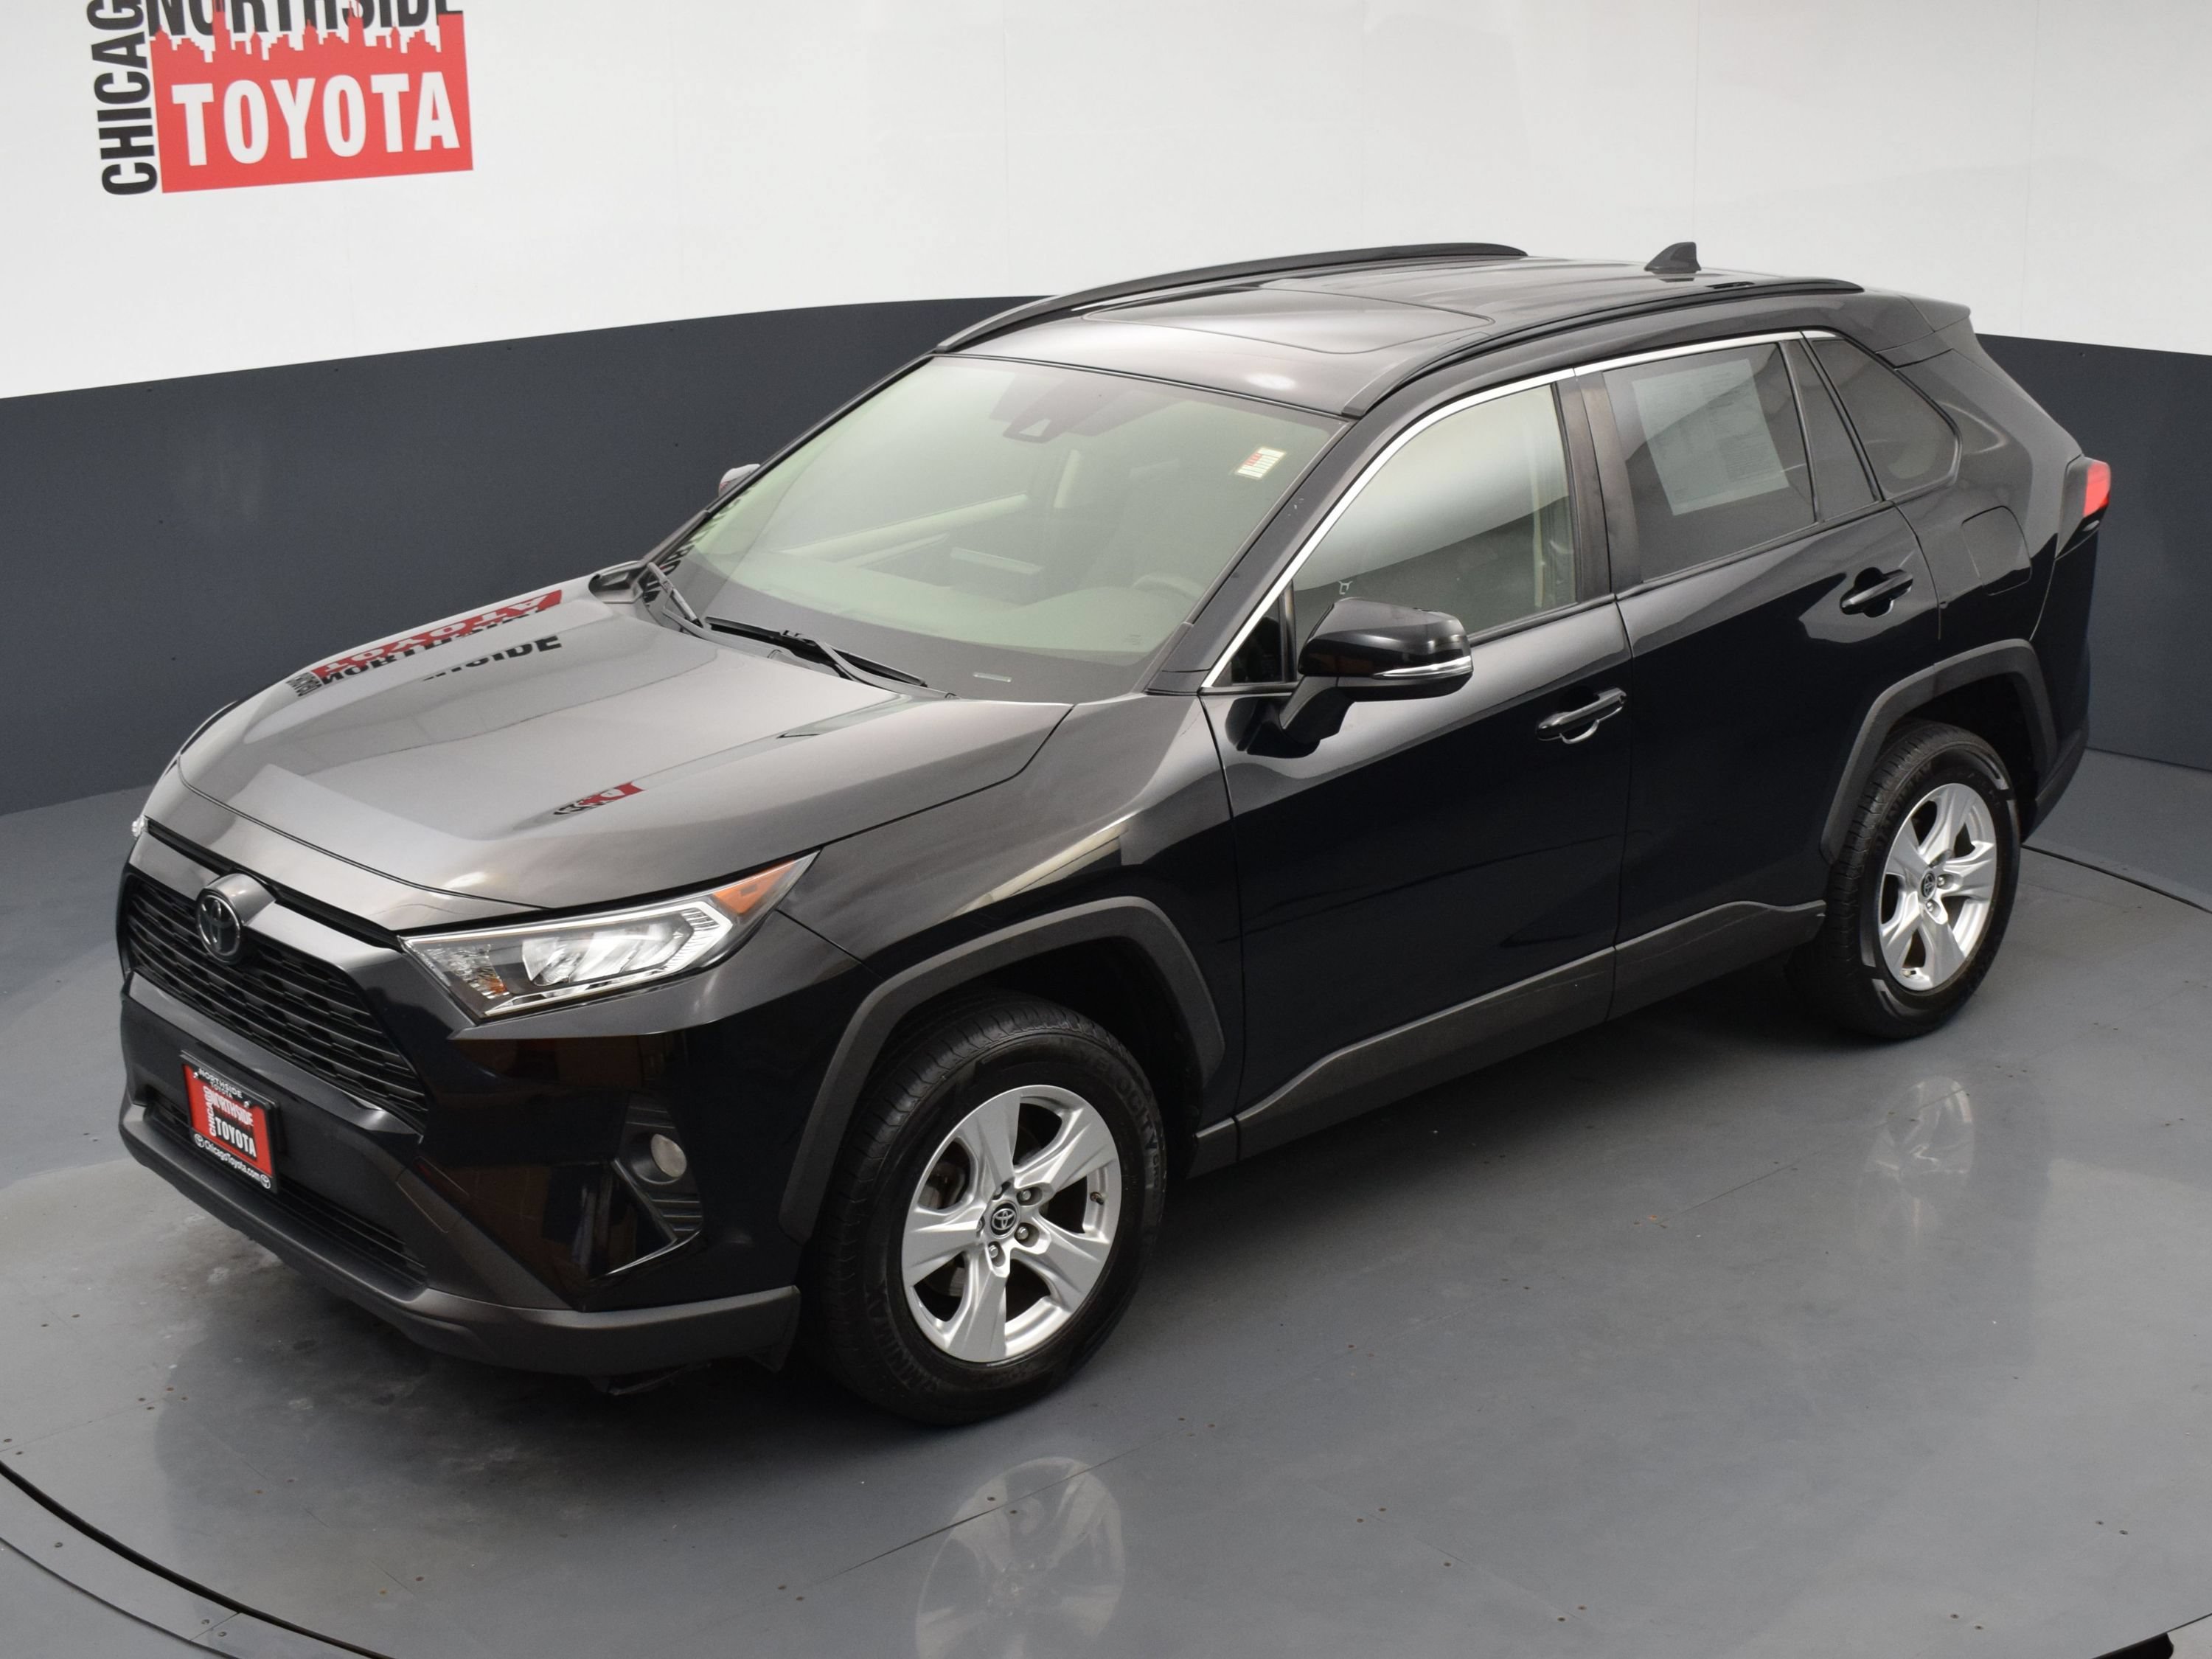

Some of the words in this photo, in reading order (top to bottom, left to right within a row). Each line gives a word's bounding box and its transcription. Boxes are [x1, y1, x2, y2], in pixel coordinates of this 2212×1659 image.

[147, 0, 463, 36] NORTHSID
[171, 72, 460, 167] TOYOTA
[198, 1068, 243, 1099] NORTHSIDE
[203, 1085, 217, 1137] CHICAGO
[215, 1116, 257, 1158] TOYOTA
